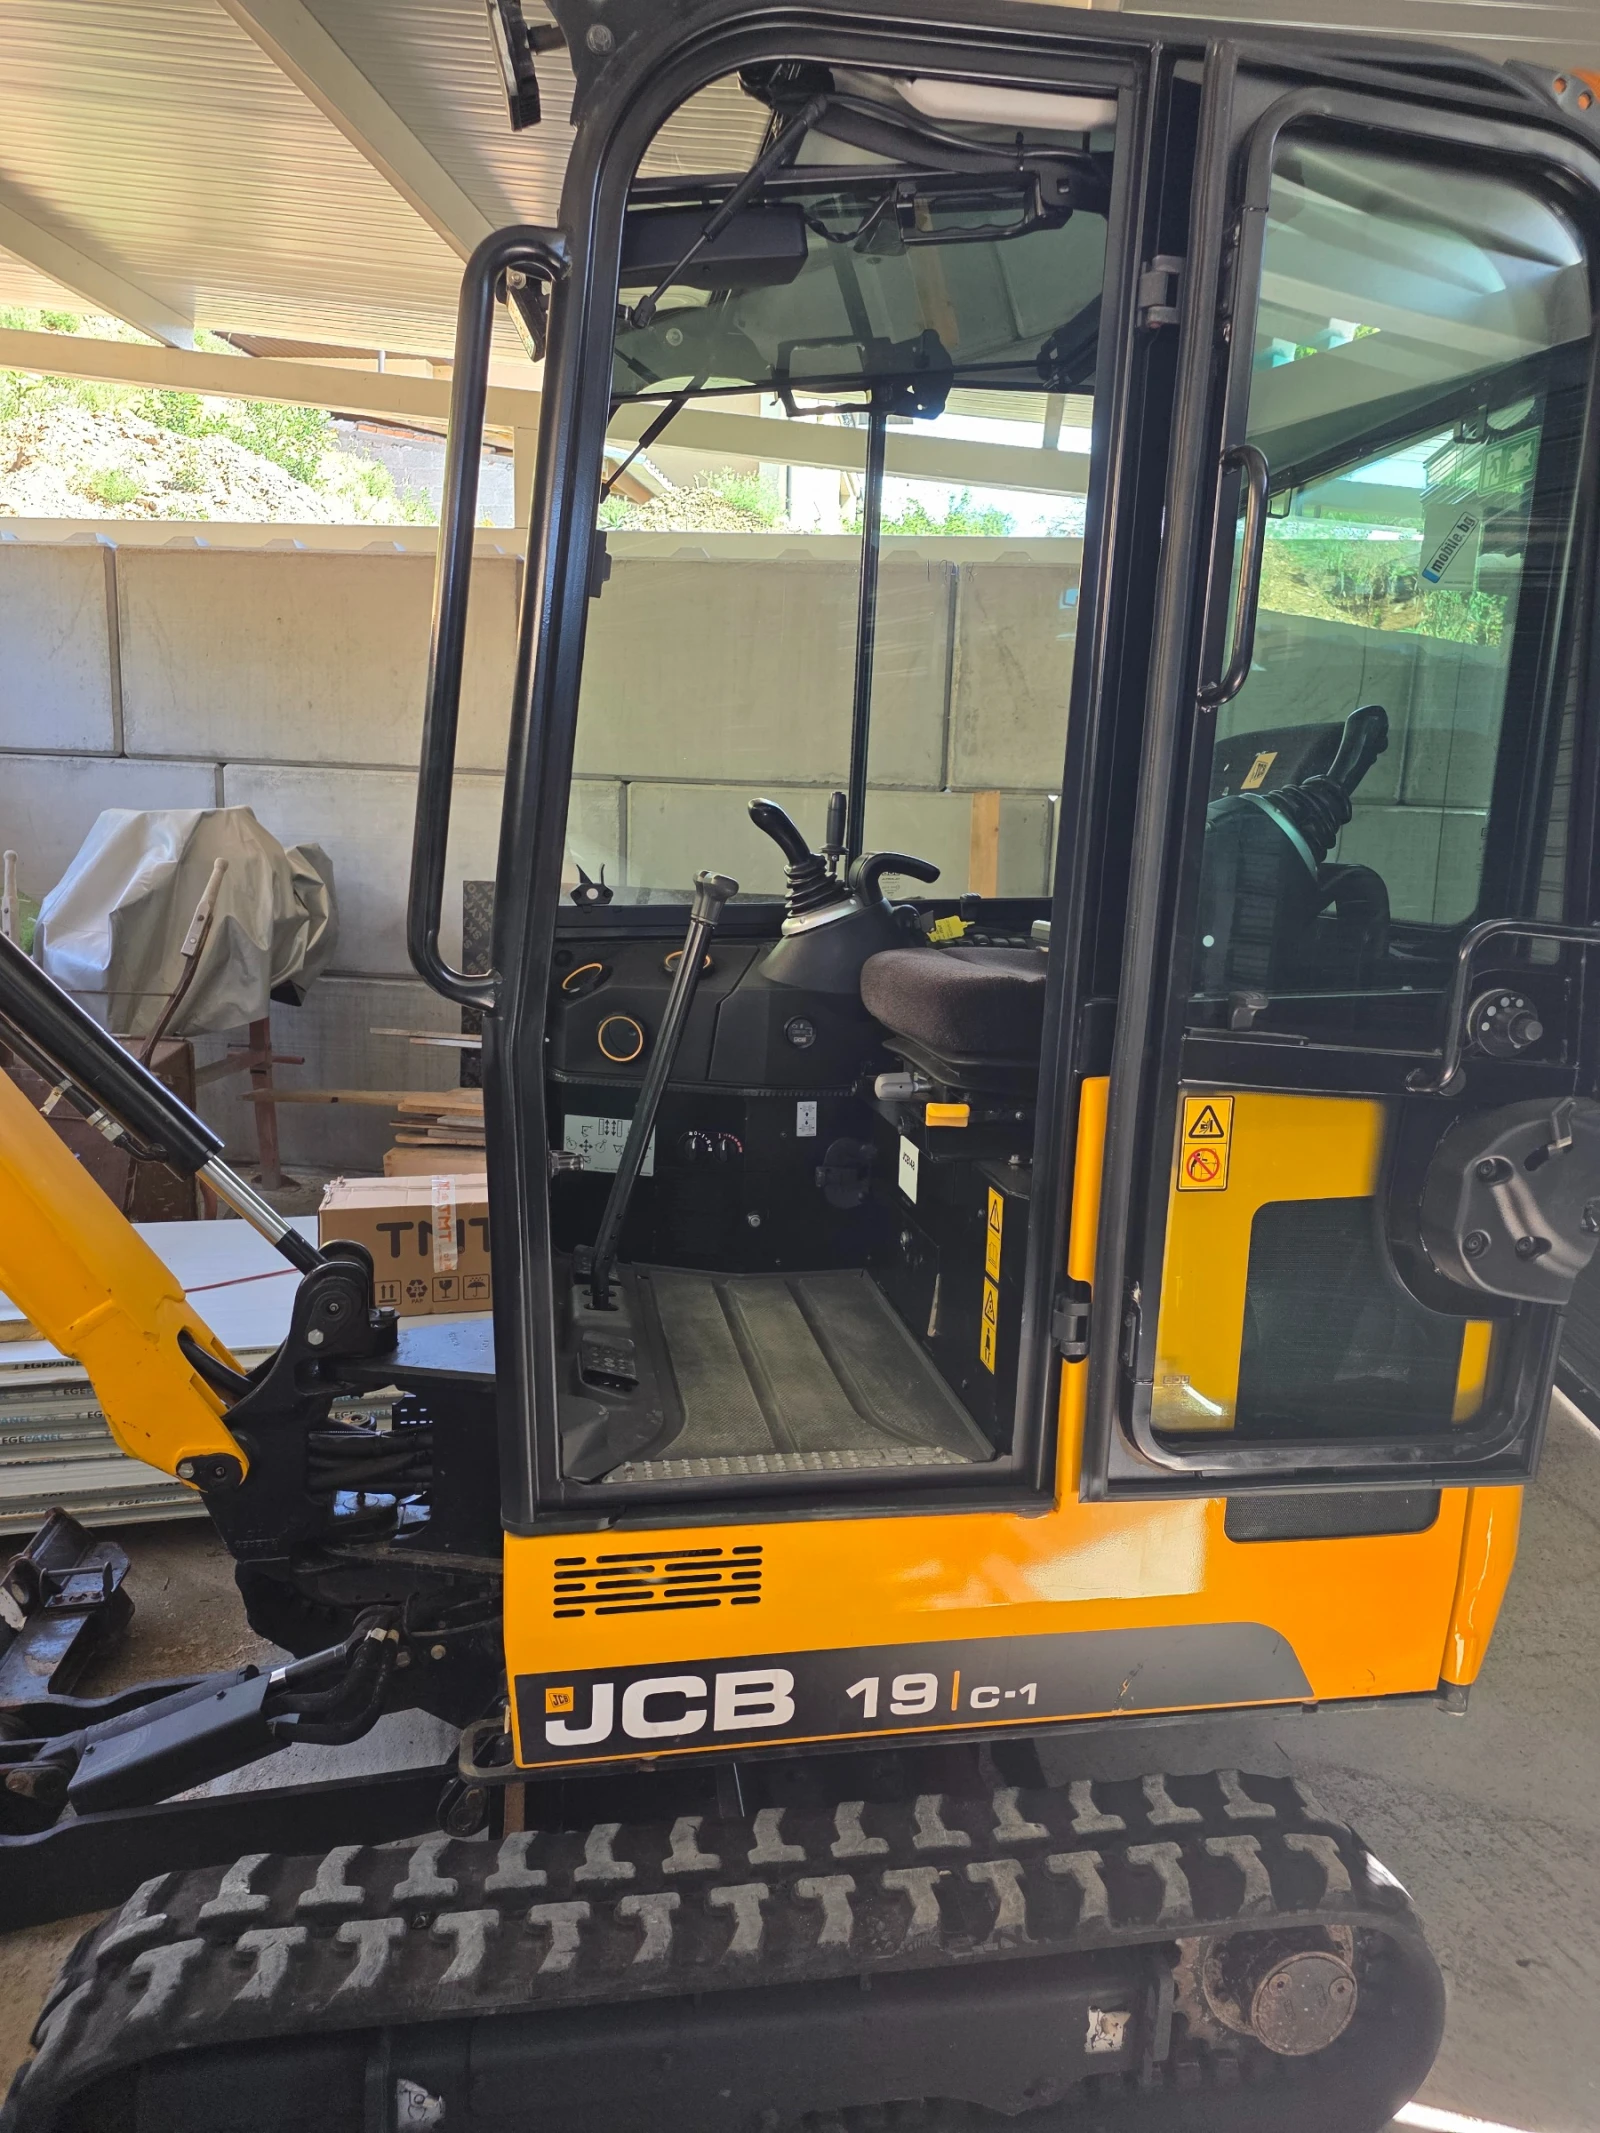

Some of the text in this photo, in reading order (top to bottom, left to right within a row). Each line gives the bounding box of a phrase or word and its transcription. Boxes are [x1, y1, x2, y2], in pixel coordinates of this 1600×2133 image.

[1431, 516, 1476, 573] mobile.bg
[2, 1433, 62, 1444] EGEPANEL
[545, 1668, 795, 1746] JCB
[846, 1673, 938, 1718] 19
[551, 1694, 569, 1706] JCB
